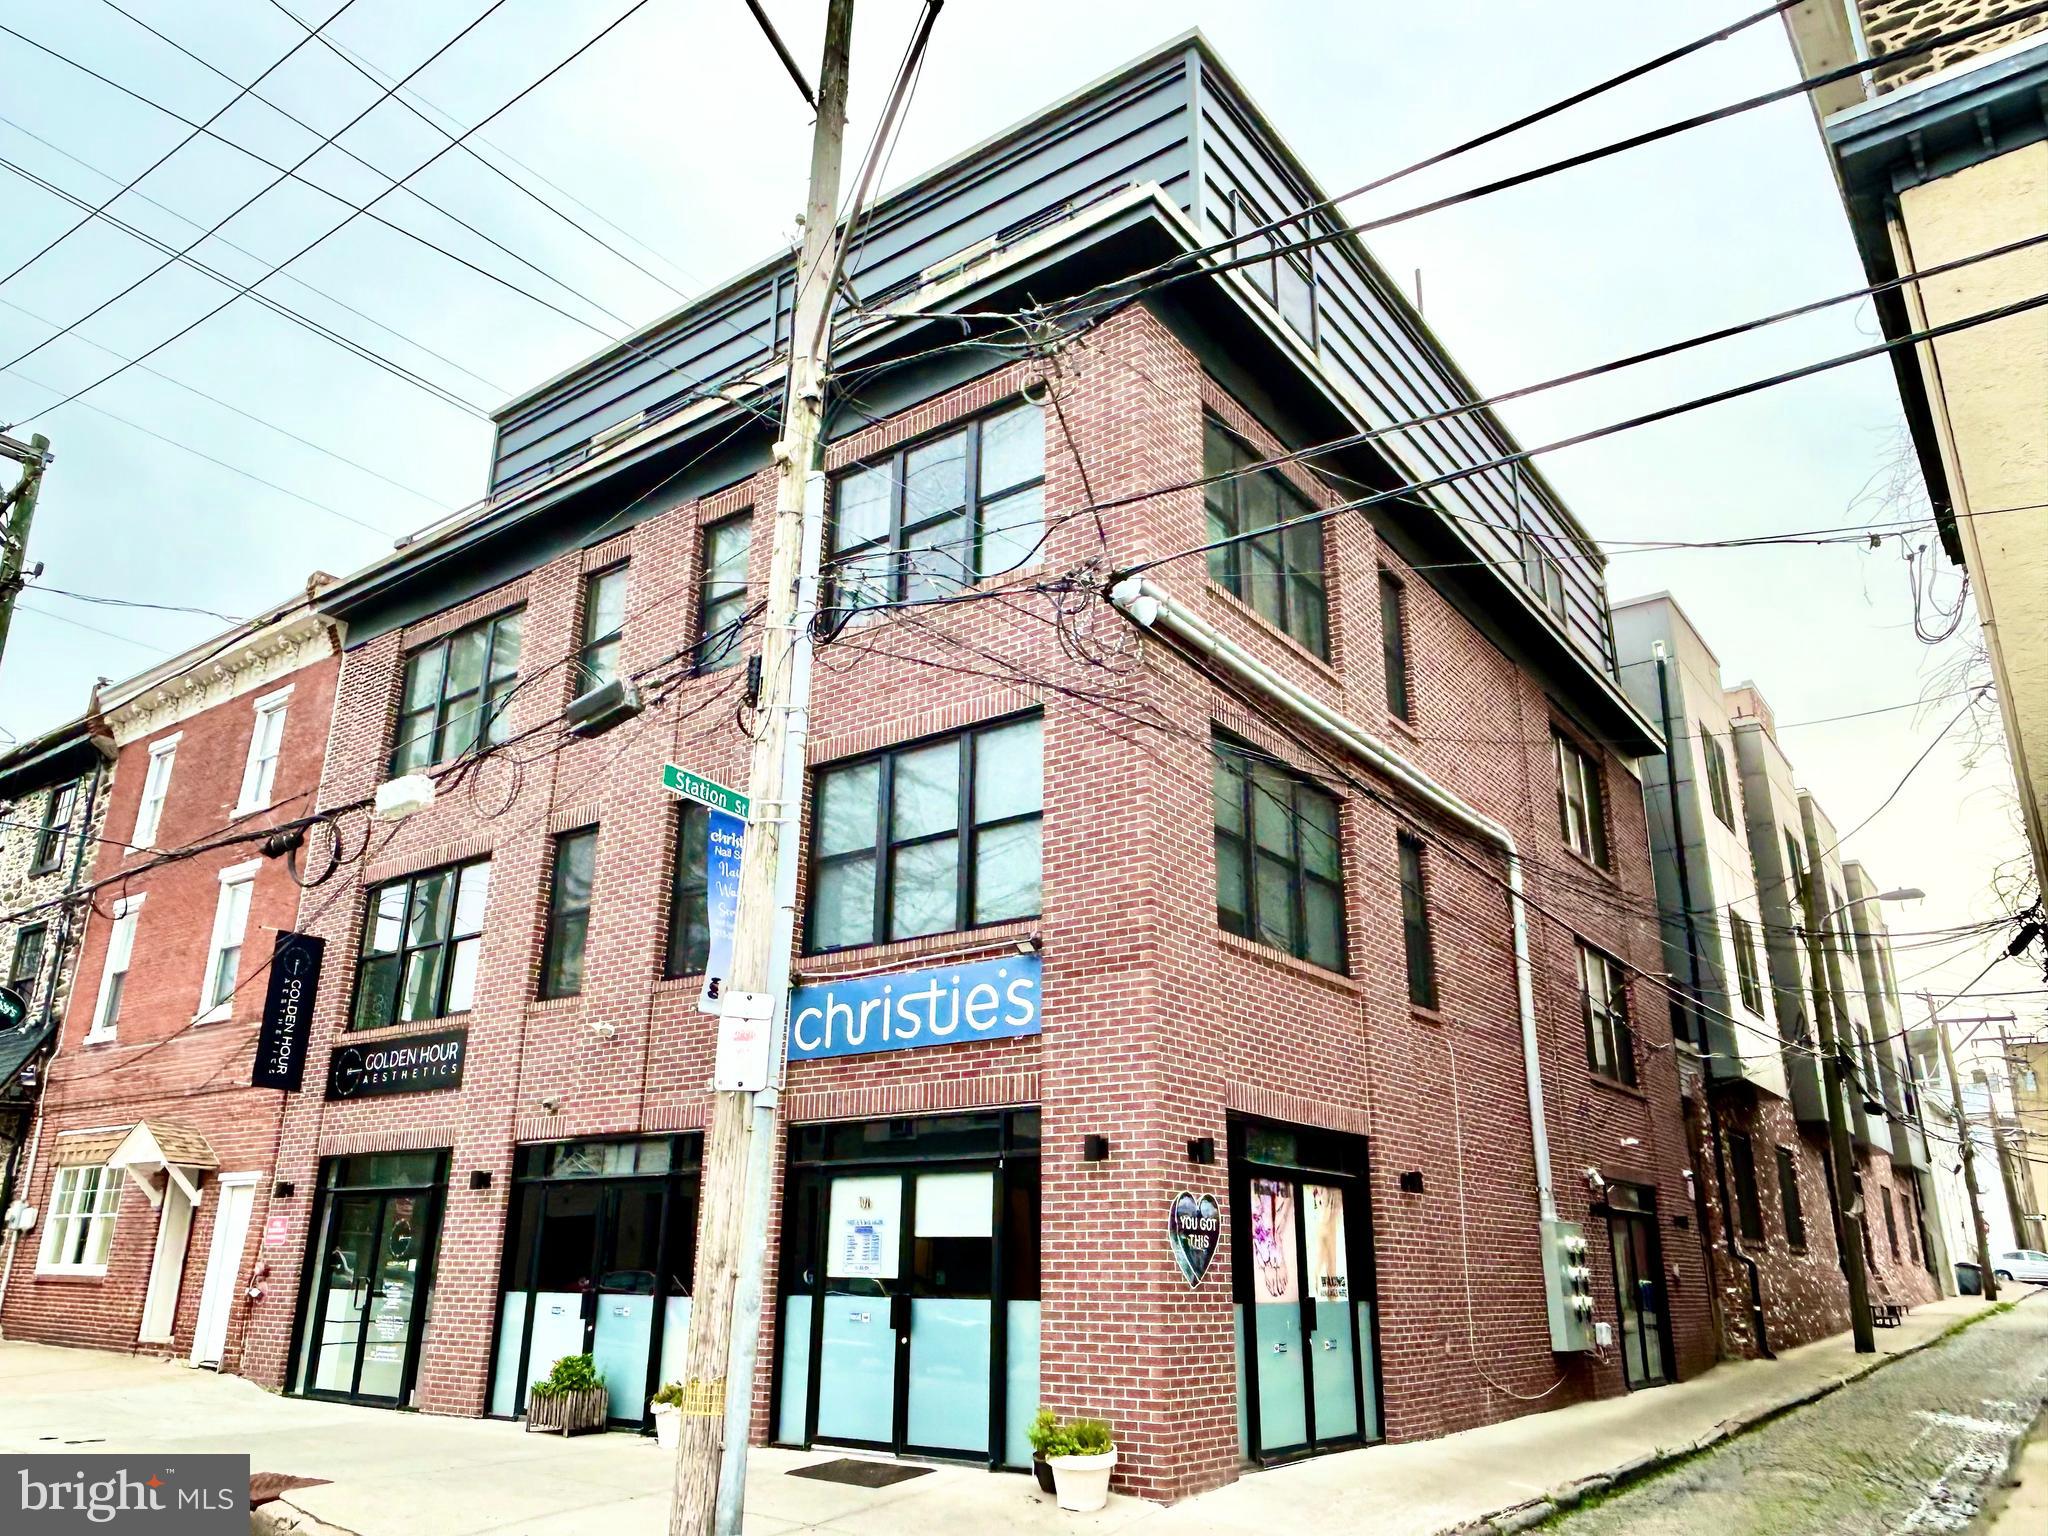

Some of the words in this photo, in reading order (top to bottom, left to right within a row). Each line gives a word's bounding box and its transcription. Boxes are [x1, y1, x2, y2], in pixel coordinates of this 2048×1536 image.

[675, 771, 727, 807] Station
[734, 801, 747, 817] St
[710, 828, 745, 849] christ
[714, 845, 732, 858] Nail
[284, 979, 302, 1033] GOLDEN
[794, 968, 1034, 1051] christie's
[276, 1036, 293, 1075] HOUR
[365, 1047, 417, 1071] GOLDEN
[420, 1041, 459, 1063] HOUR
[362, 1063, 458, 1084] AESTHETICS
[1180, 1215, 1198, 1231] YOU
[1199, 1217, 1217, 1232] GOT
[1188, 1233, 1210, 1249] THIS
